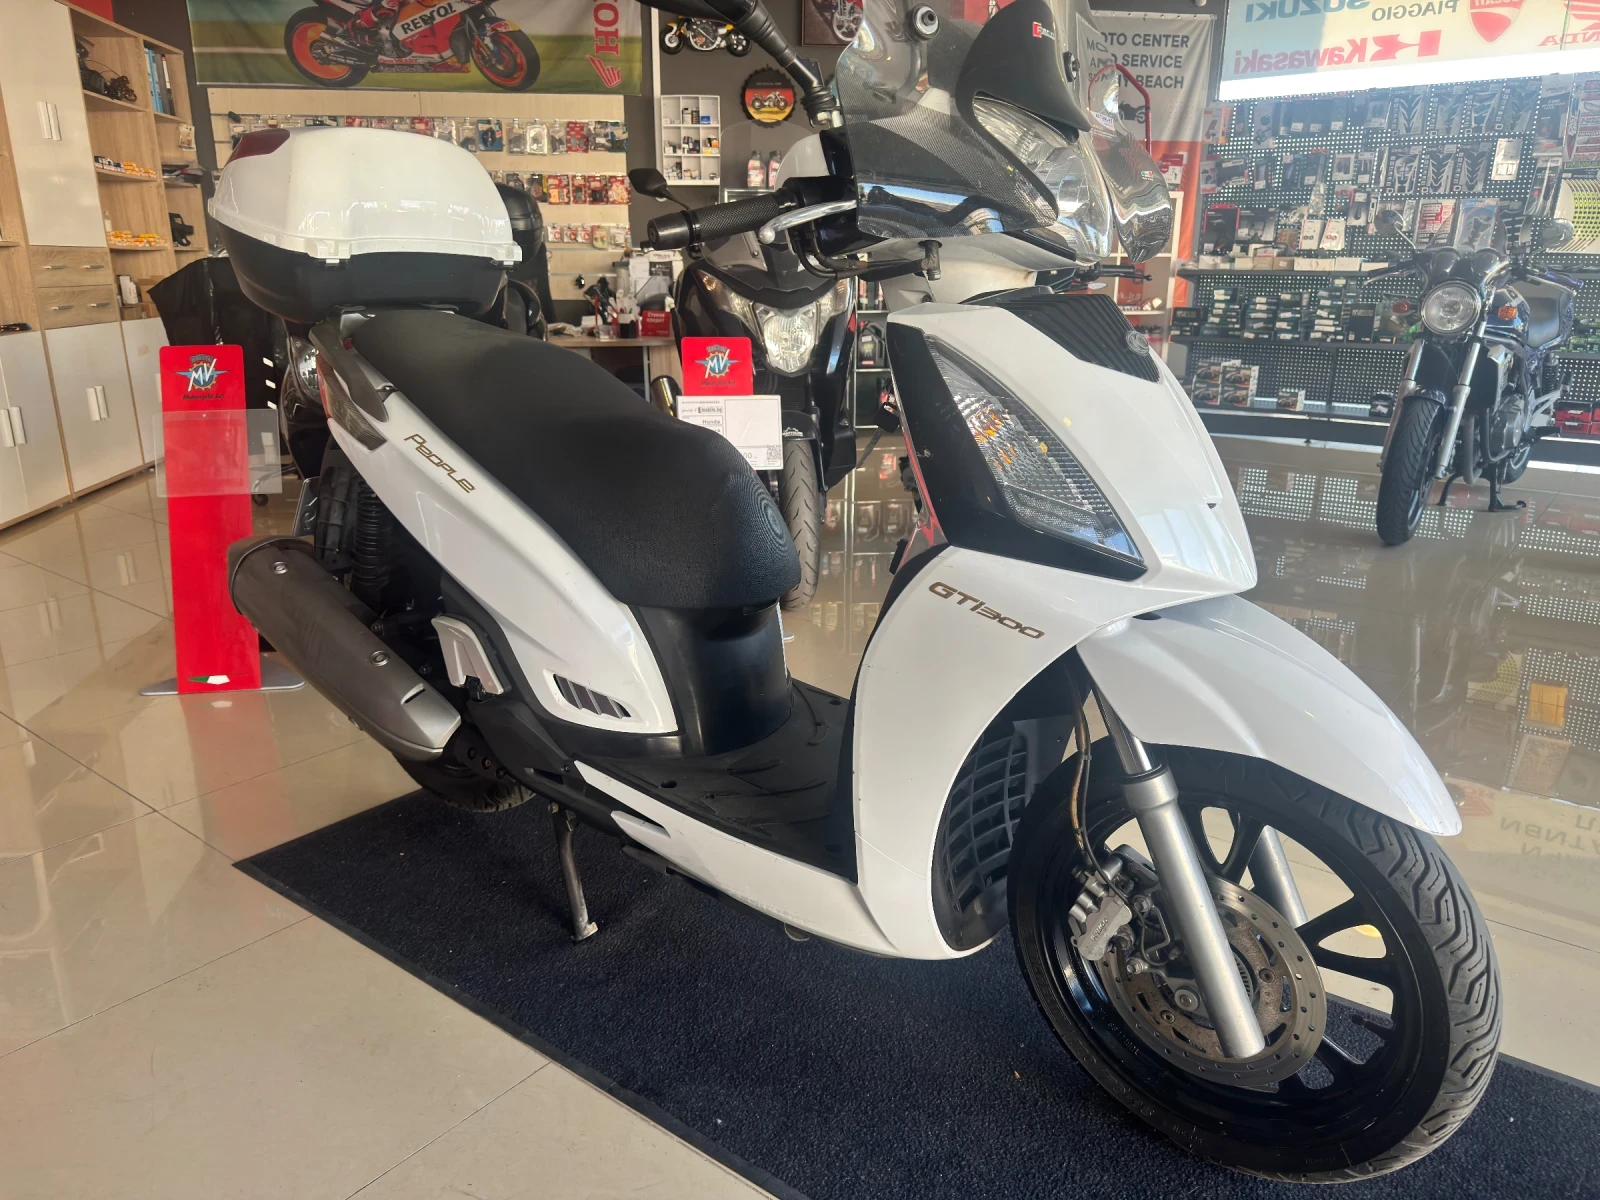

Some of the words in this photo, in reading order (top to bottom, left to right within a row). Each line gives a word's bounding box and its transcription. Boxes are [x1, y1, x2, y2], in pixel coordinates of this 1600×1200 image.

[594, 0, 619, 56] HO
[1131, 33, 1190, 48] CENTER
[1121, 54, 1182, 69] SERVICE
[1137, 75, 1184, 89] BEACH
[188, 358, 217, 392] MV
[705, 349, 730, 379] MV
